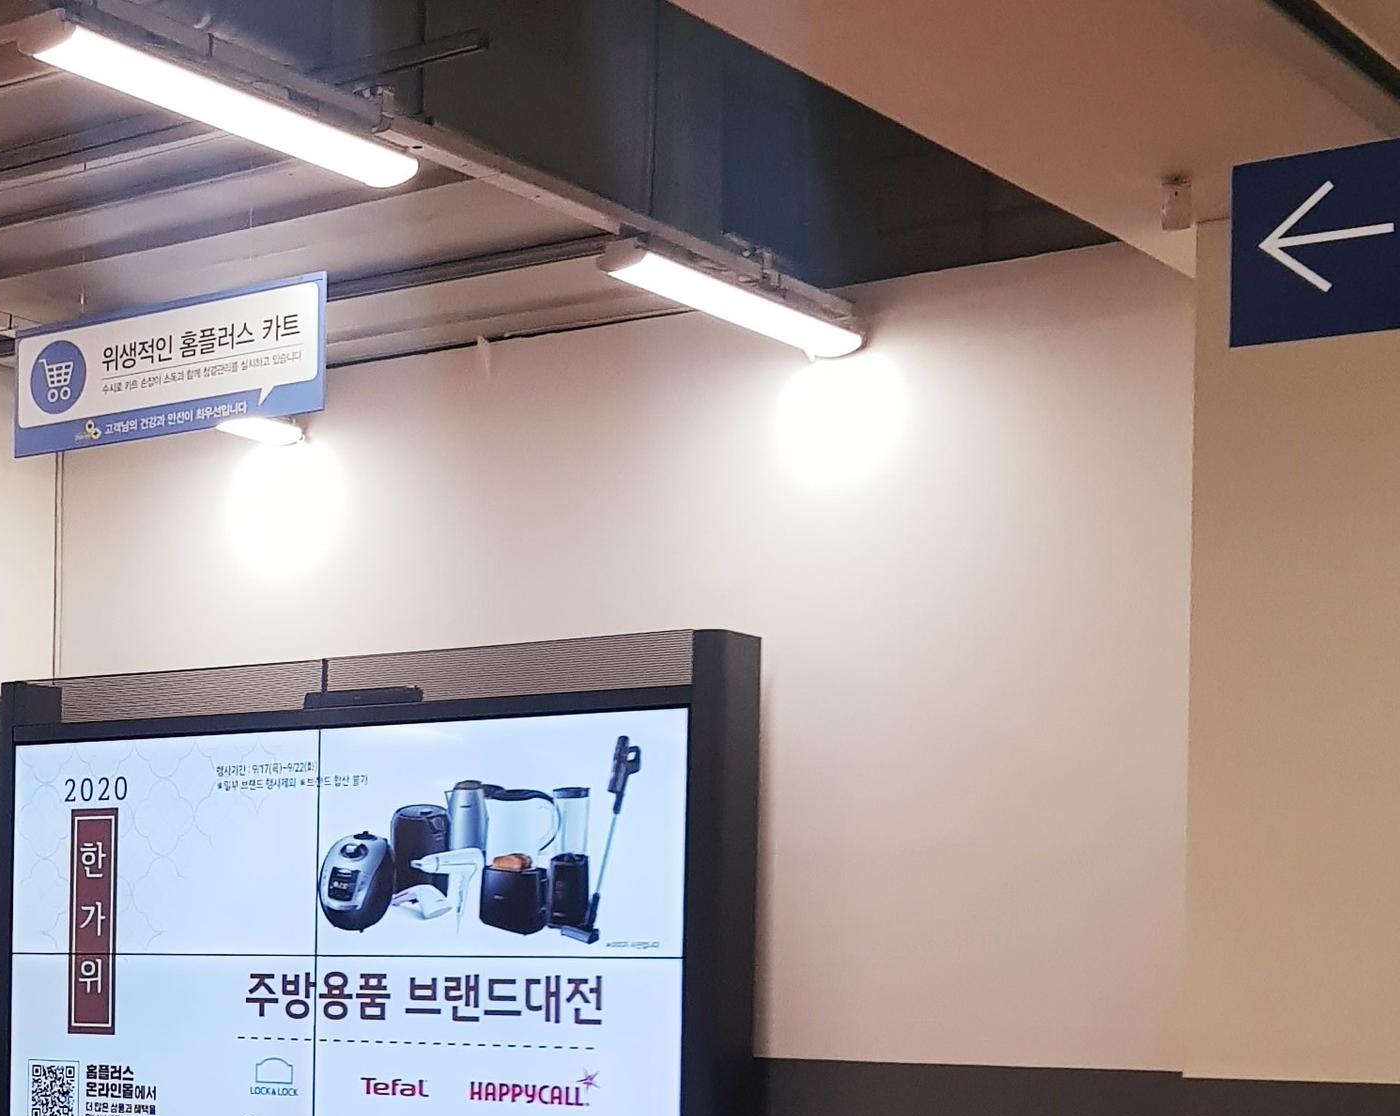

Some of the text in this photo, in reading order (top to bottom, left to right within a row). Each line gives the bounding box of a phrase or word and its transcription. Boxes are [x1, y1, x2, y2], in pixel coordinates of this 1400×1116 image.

[102, 313, 301, 372] 위생적인 홈플러스 카트
[104, 401, 248, 435] 고객님의 건강과 안전이 최우선입니다
[64, 776, 128, 802] 2020
[245, 971, 603, 1026] 주방용품 브랜드대전
[86, 1064, 134, 1081] 홈플러스
[86, 1082, 156, 1100] 온라인몰에서
[250, 1086, 299, 1097] LOCK&LOCK
[361, 1077, 430, 1098] Tefal
[470, 1081, 584, 1107] HAPPYCALL
[86, 1101, 93, 1111] 더
